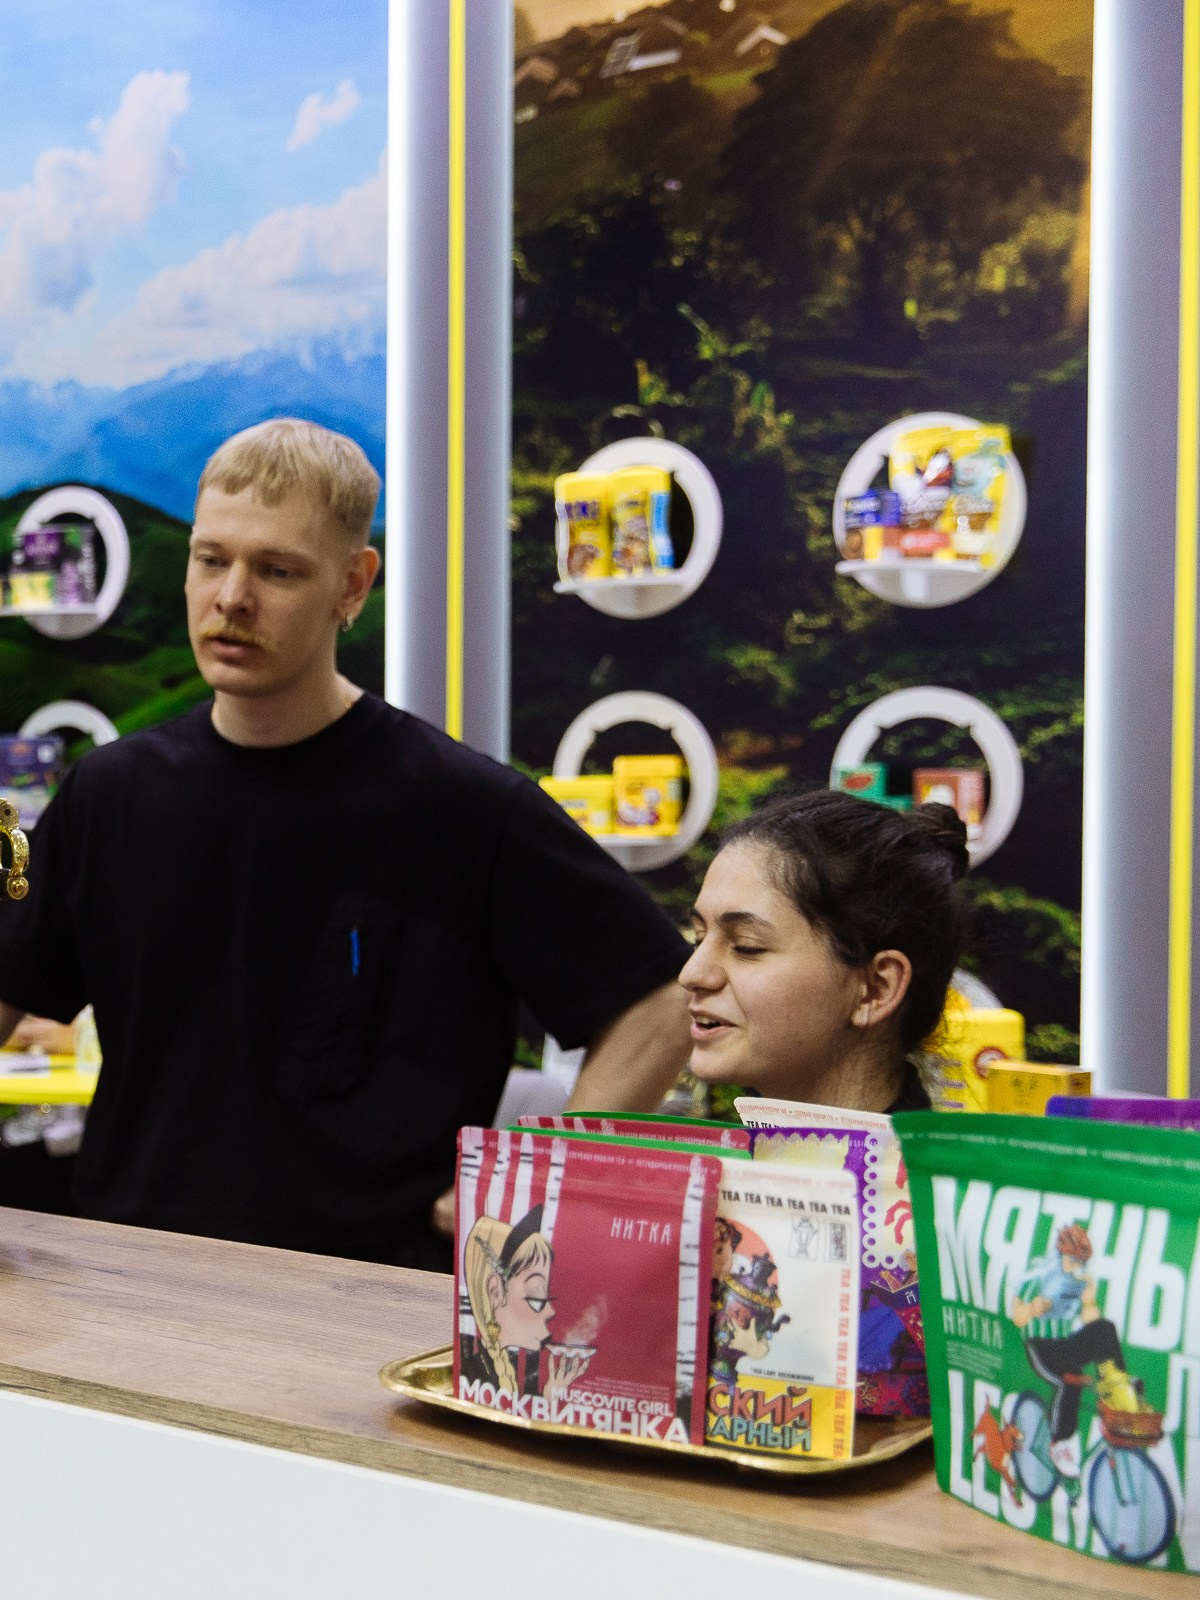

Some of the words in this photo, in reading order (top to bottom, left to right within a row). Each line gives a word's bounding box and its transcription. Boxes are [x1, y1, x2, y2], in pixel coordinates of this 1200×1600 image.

[722, 1190, 740, 1202] TEA
[744, 1192, 761, 1204] TEA
[765, 1195, 783, 1207] TEA
[787, 1198, 805, 1210] TEA
[808, 1200, 827, 1213] TEA
[831, 1203, 851, 1216] TEA
[610, 1217, 671, 1245] НИТКА
[459, 1375, 690, 1445] МОСКВИТЯНКА
[550, 1386, 635, 1413] MUSCOVITE
[638, 1399, 674, 1418] GIRL
